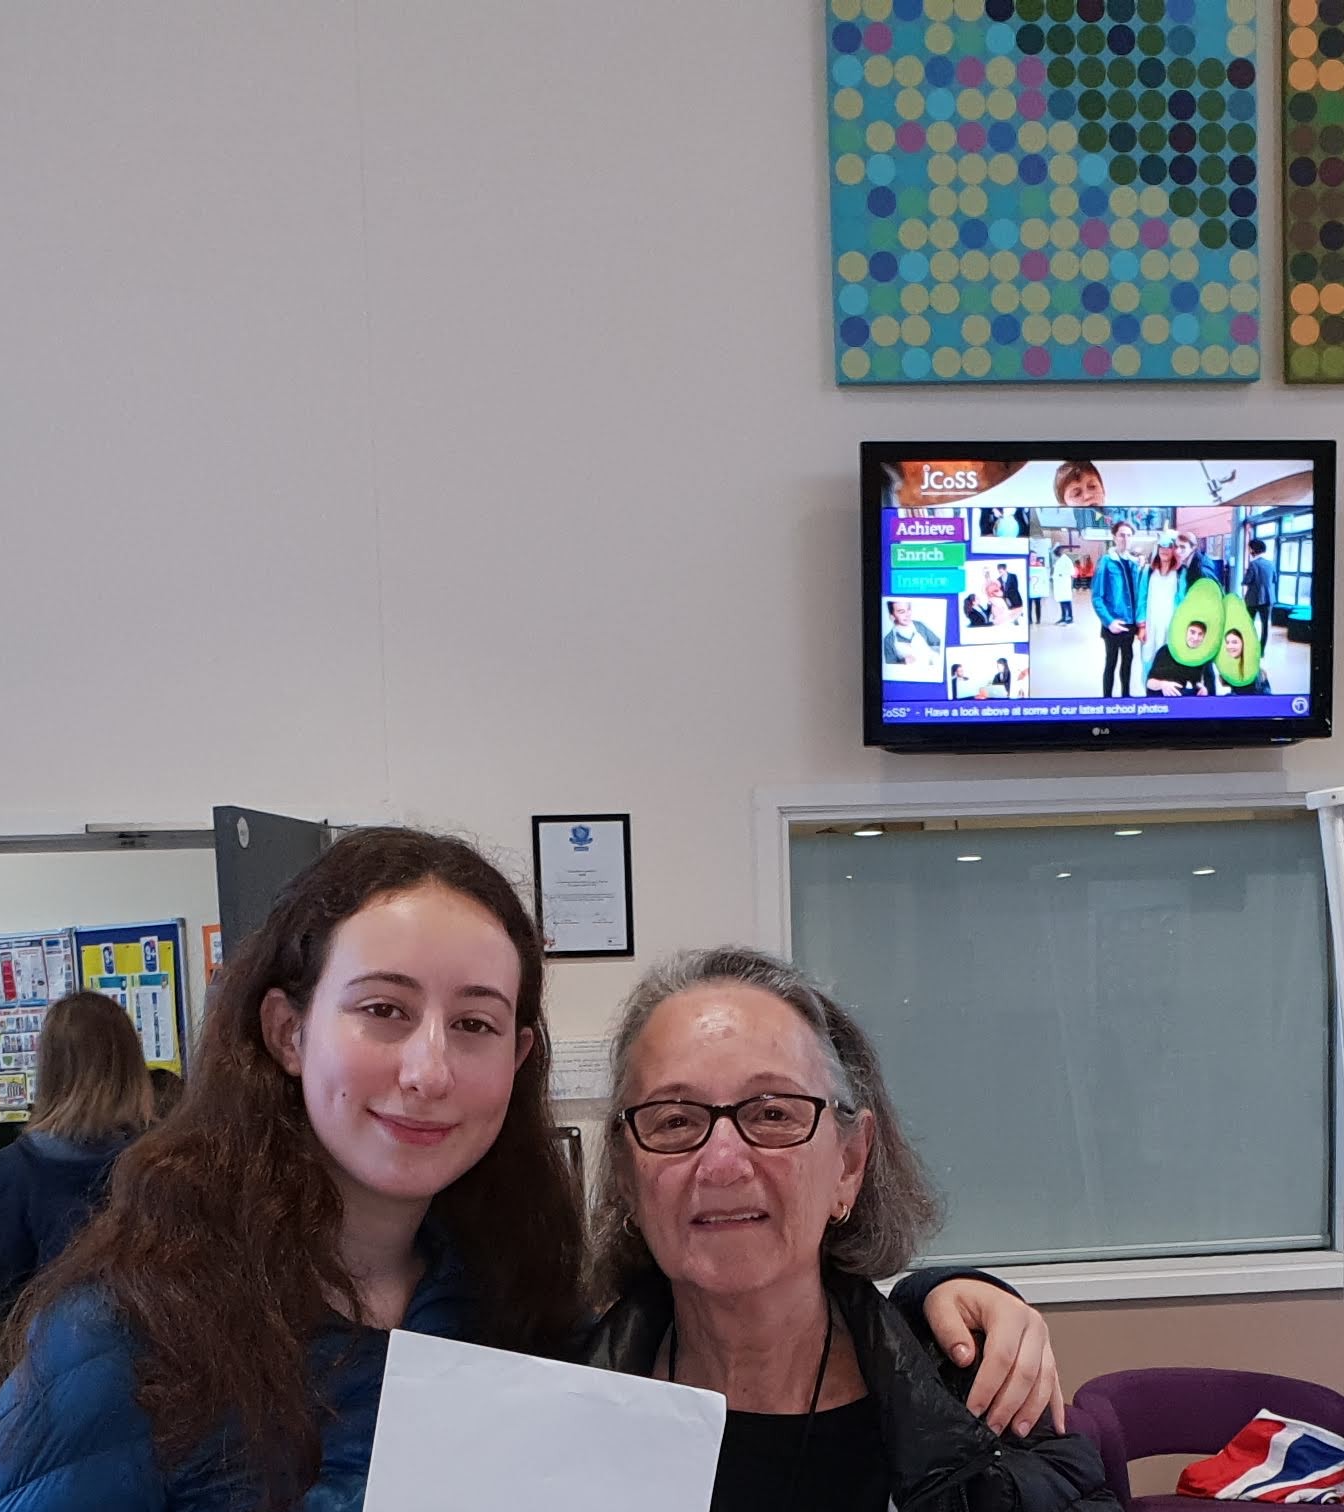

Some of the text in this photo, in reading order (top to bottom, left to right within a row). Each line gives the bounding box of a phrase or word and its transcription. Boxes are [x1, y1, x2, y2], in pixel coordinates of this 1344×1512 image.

[896, 521, 955, 536] Achieve
[897, 547, 944, 561] Enrich
[897, 574, 949, 592] Inspire
[924, 707, 949, 717] Have
[951, 709, 959, 717] a
[959, 706, 979, 717] look
[981, 706, 1010, 717] above
[1011, 707, 1021, 717] at
[1022, 707, 1049, 716] some
[1050, 705, 1060, 715] of
[1061, 707, 1077, 715] our
[1079, 705, 1104, 715] latest
[1105, 704, 1136, 714] school
[1137, 704, 1169, 716] photos
